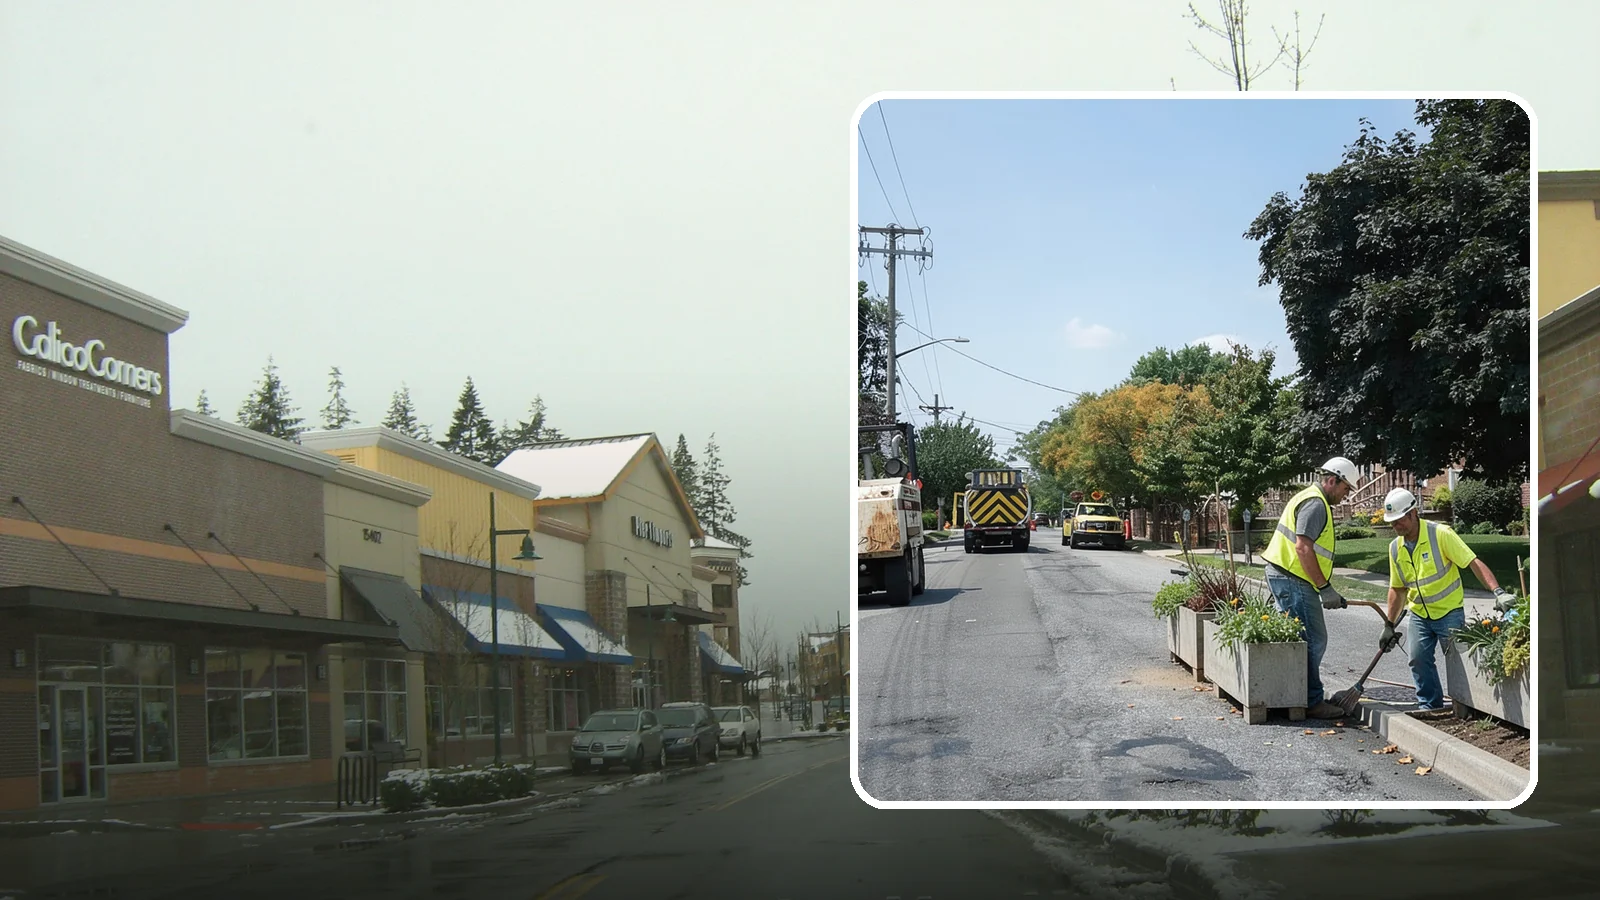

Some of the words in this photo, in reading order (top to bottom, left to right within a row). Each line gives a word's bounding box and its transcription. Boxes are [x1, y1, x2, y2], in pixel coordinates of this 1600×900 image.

[17, 360, 47, 377] FABRICS
[51, 370, 78, 386] WINDOW
[79, 378, 116, 397] TREATMENTS
